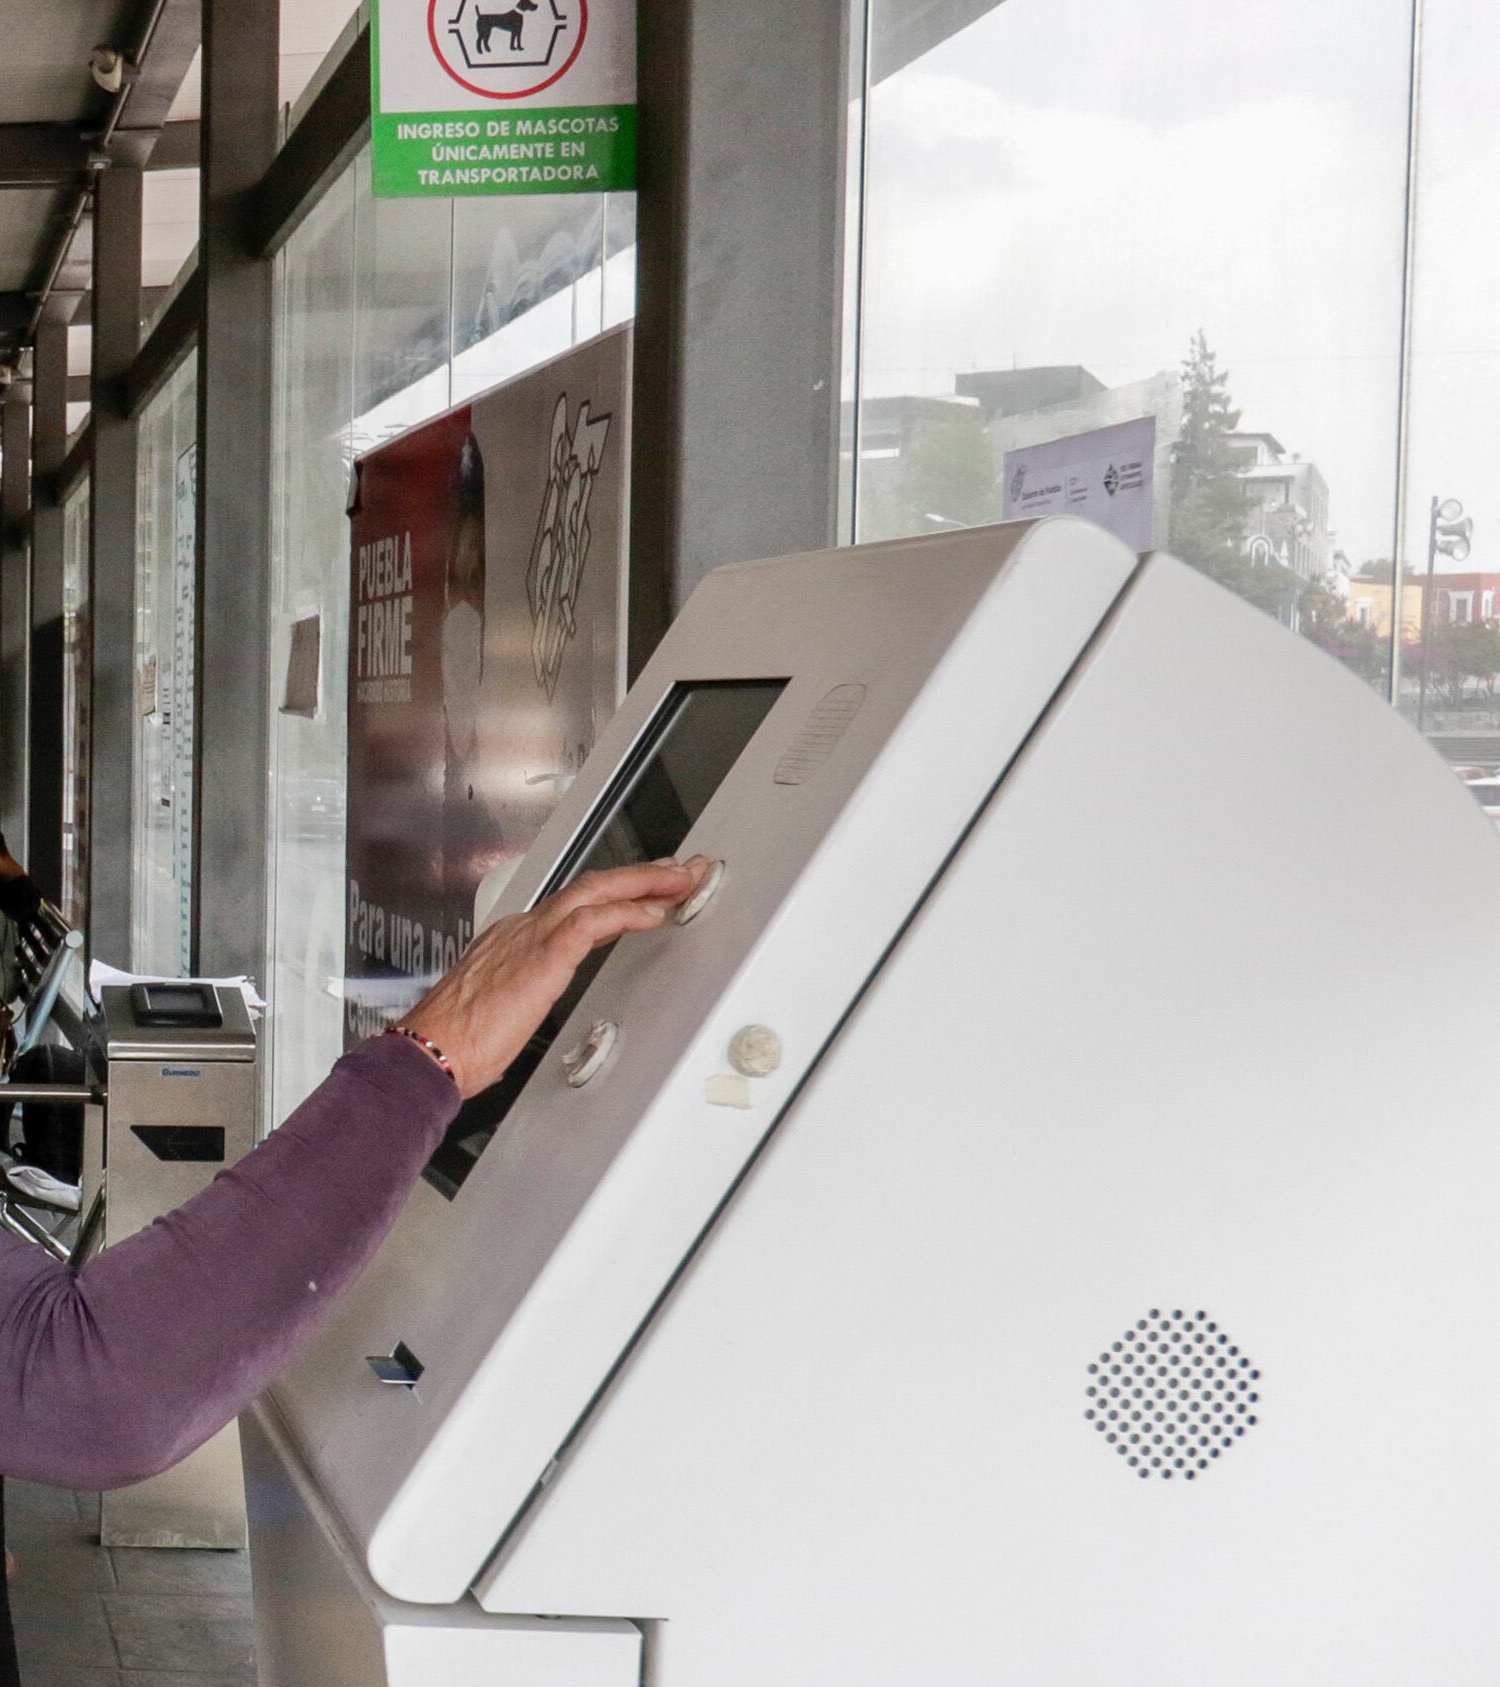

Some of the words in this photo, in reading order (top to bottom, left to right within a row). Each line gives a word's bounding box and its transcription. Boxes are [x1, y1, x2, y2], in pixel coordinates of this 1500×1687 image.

[397, 121, 480, 140] INGRESO
[486, 120, 510, 137] DE
[515, 117, 620, 136] MASCOTAS
[431, 142, 554, 162] ÚNICAMENTE
[560, 141, 585, 157] EN
[418, 164, 599, 185] TRANSPORTADORA
[359, 531, 412, 601] PUEBLA
[357, 595, 413, 677] FIRME
[349, 879, 386, 962] Para
[390, 912, 425, 978] una
